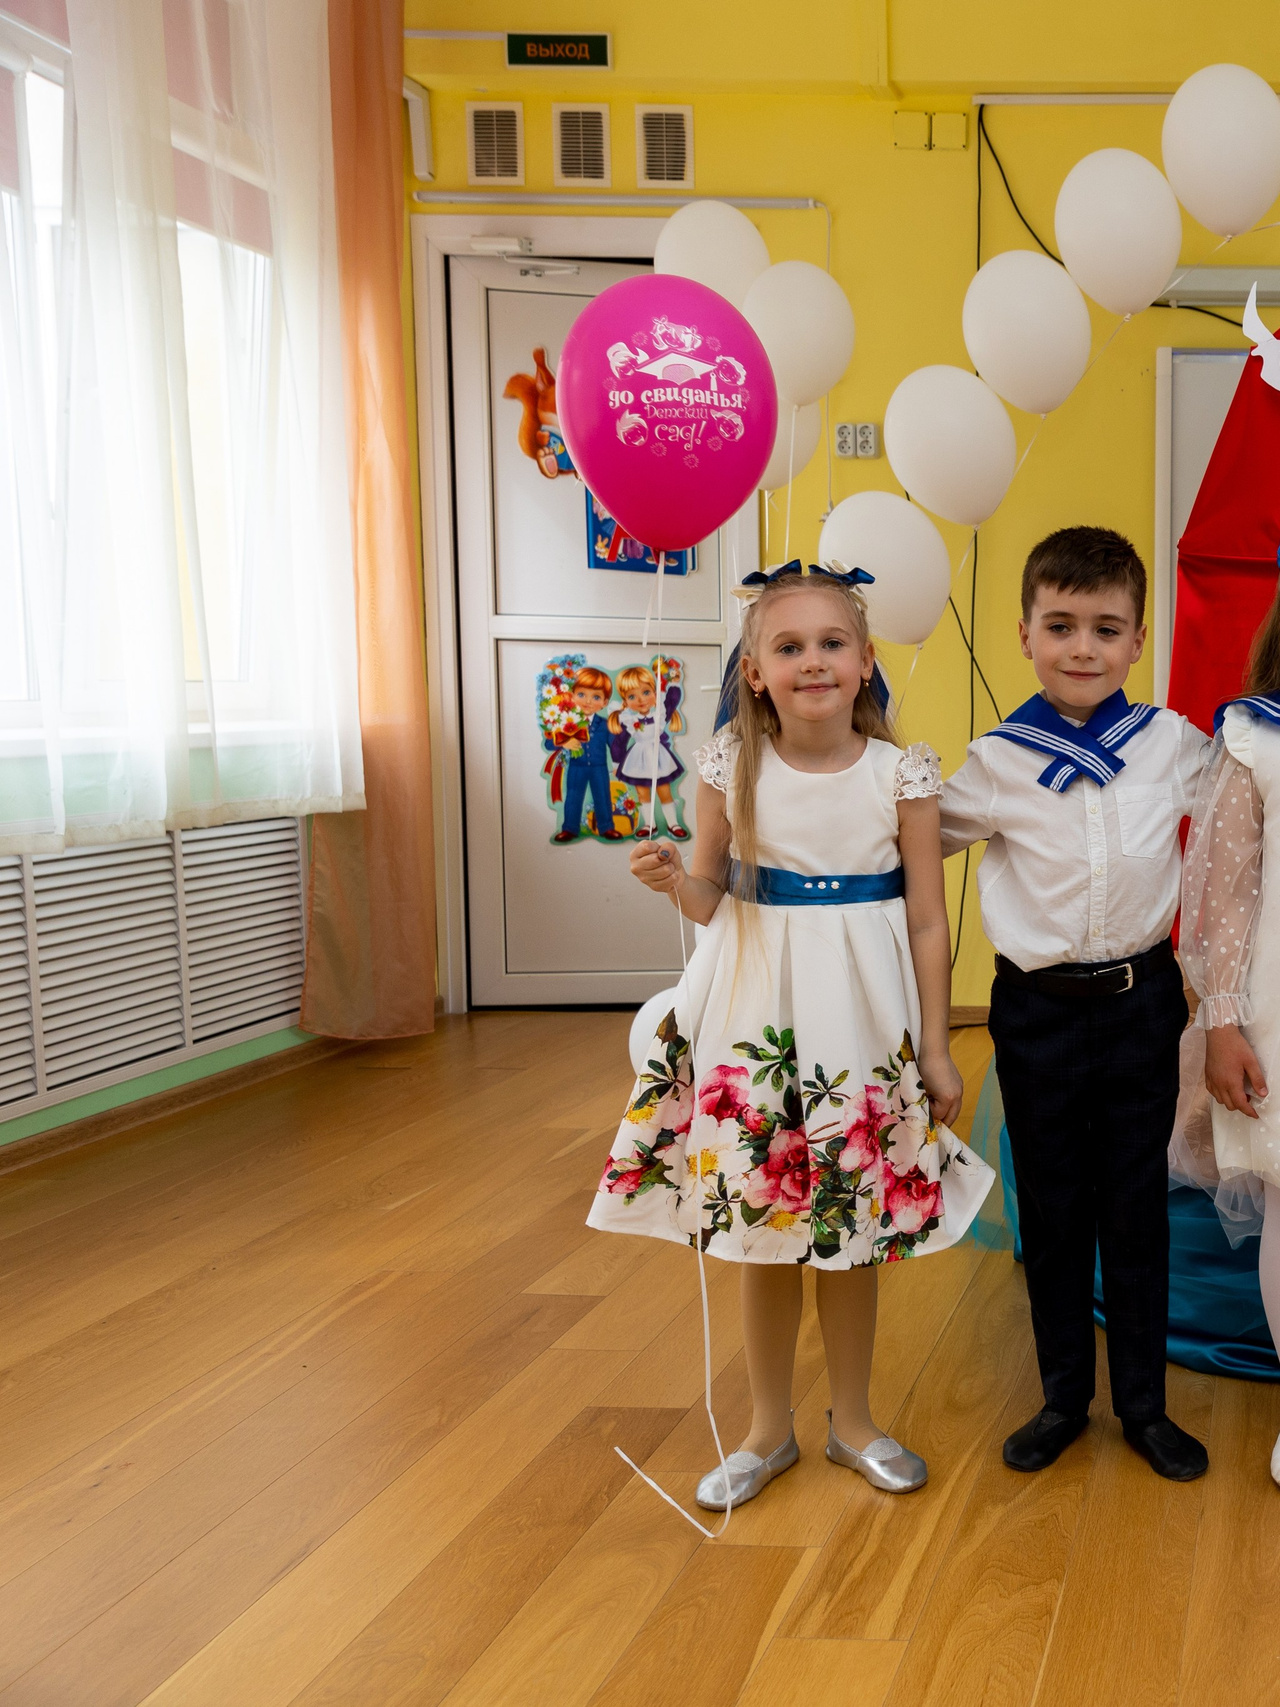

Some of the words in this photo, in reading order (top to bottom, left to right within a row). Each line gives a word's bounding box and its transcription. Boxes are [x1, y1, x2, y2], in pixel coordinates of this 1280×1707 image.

[526, 42, 590, 60] ВЫХОД
[608, 390, 634, 409] до
[644, 404, 708, 419] Детский
[654, 420, 707, 451] сад!
